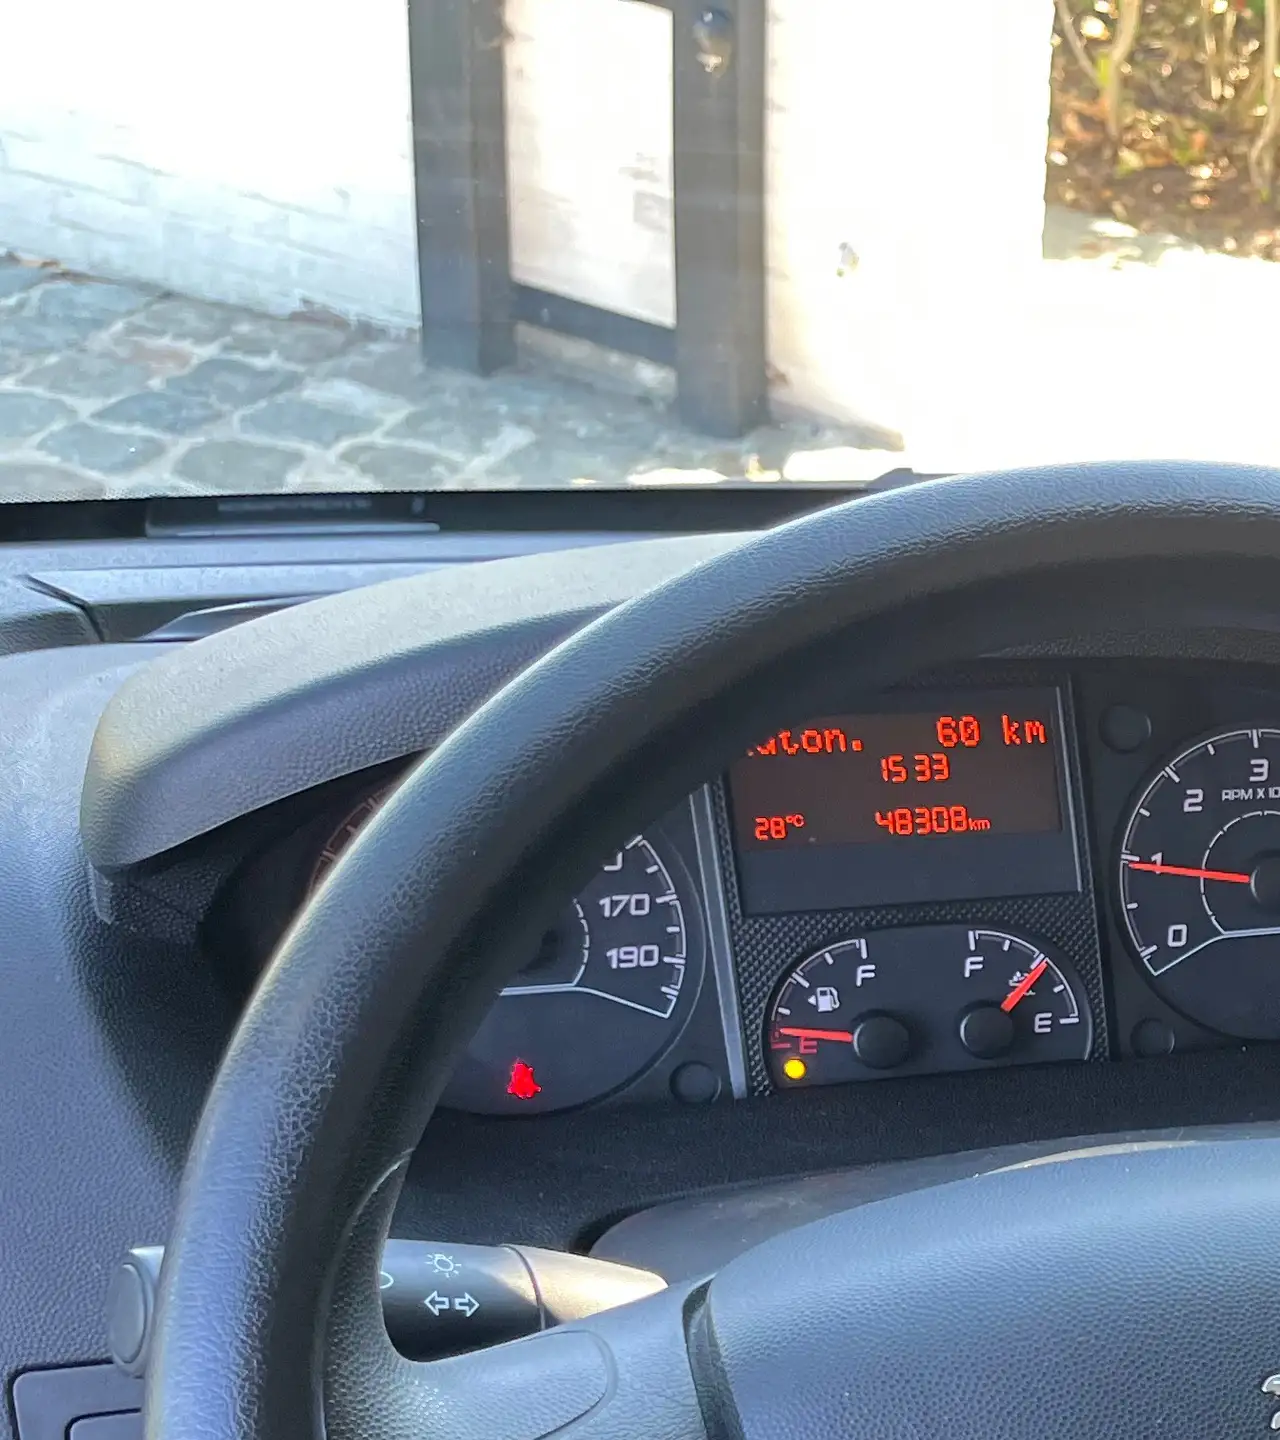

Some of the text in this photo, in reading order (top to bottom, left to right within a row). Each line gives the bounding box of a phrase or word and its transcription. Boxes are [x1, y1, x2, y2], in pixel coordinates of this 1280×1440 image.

[747, 714, 1047, 755] uton. 60 km
[881, 752, 949, 783] 1533
[1250, 758, 1270, 782] 3
[1183, 788, 1204, 813] 2
[1221, 788, 1253, 802] RPM
[1256, 787, 1265, 800] X
[599, 893, 650, 917] 170
[1167, 923, 1188, 948] 0
[606, 945, 660, 969] 190
[964, 956, 984, 978] F
[856, 964, 876, 987] F
[1033, 1012, 1053, 1034] E
